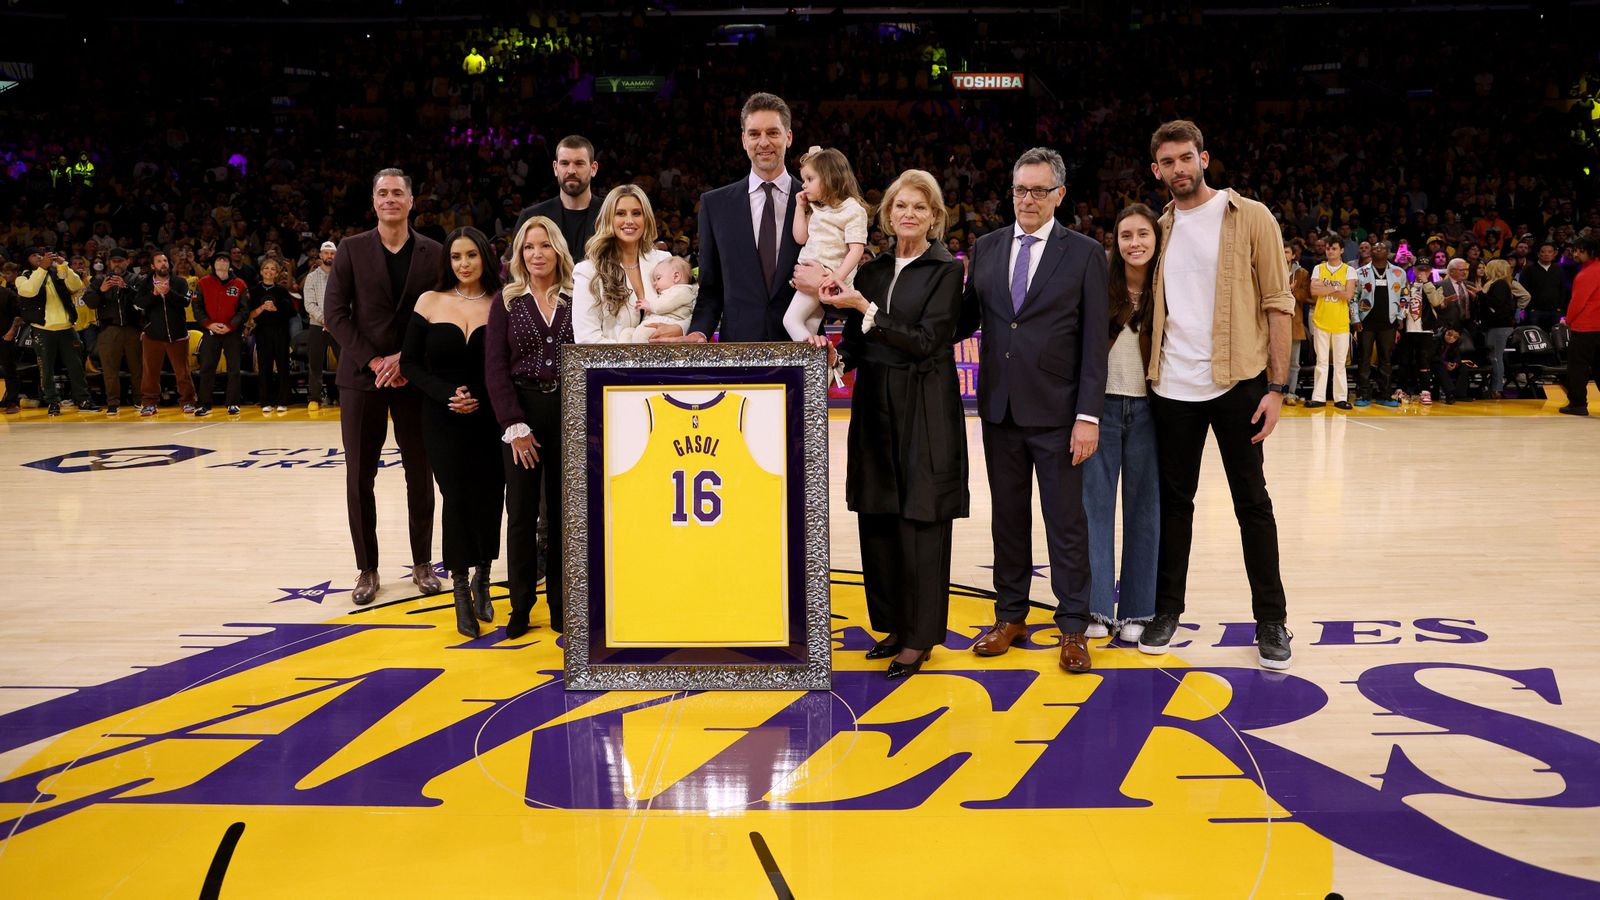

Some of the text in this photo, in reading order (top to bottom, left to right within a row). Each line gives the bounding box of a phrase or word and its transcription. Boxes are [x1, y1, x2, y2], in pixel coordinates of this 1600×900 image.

[953, 76, 1022, 88] TOSHIBA
[672, 435, 720, 457] GASOL
[671, 469, 723, 526] 16
